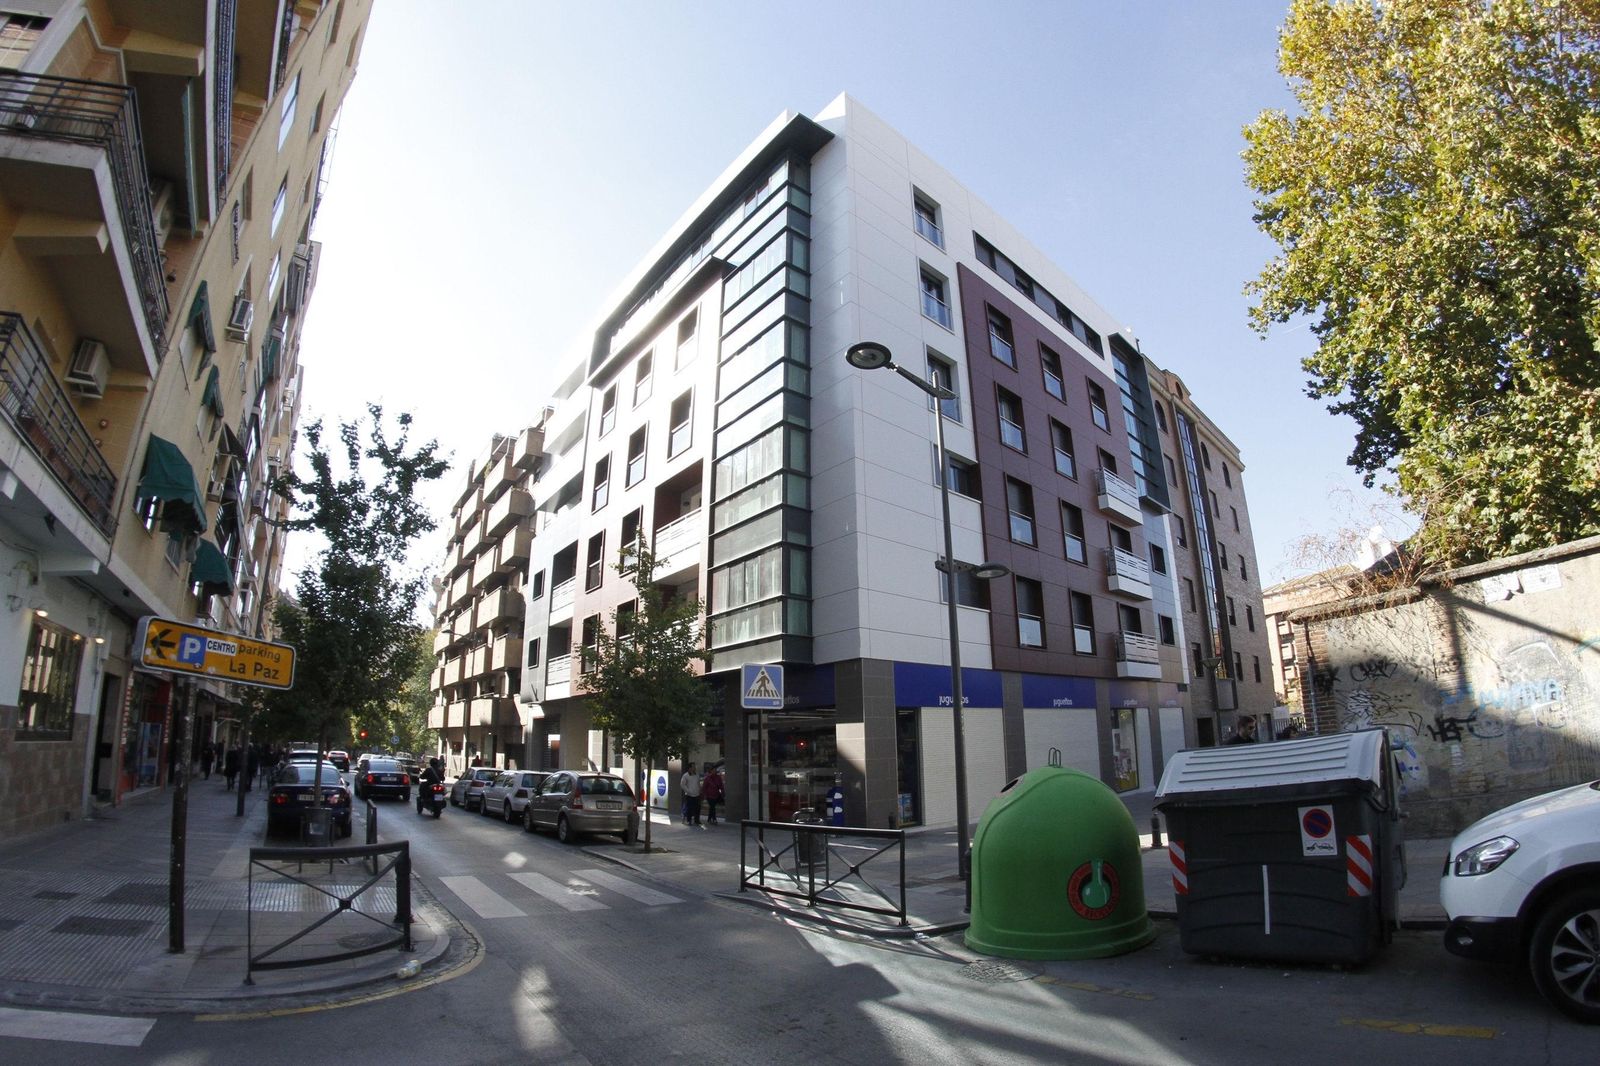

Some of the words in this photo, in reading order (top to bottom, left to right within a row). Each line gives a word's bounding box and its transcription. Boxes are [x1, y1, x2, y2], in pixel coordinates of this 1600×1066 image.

[183, 637, 201, 660] P
[207, 640, 236, 654] CENTRO
[239, 644, 281, 663] parking
[229, 658, 246, 675] La
[253, 662, 280, 680] Paz
